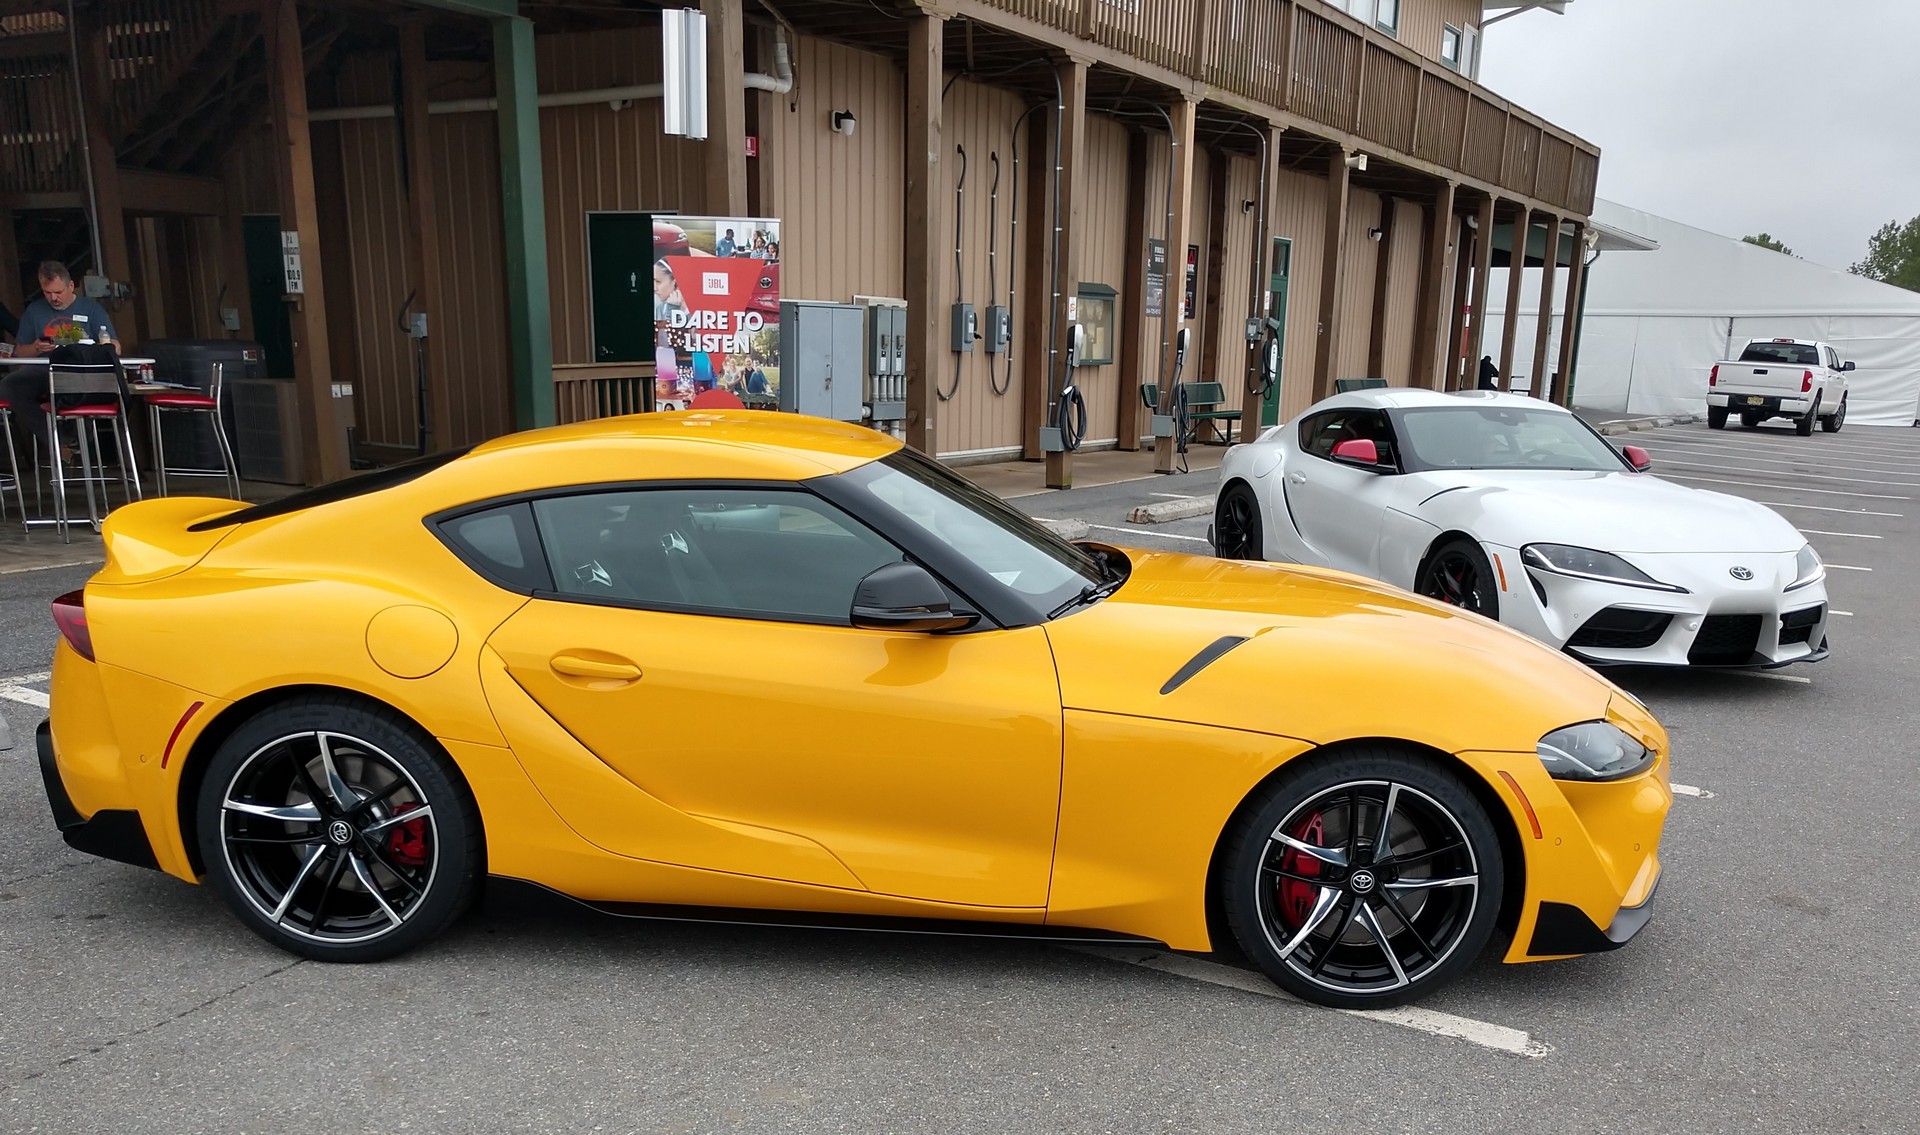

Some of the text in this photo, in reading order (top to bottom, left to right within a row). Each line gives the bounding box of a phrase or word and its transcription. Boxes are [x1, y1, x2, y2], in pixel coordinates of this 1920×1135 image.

[708, 278, 724, 289] JBL
[671, 310, 764, 332] DARE TO
[685, 333, 750, 354] LISTEN
